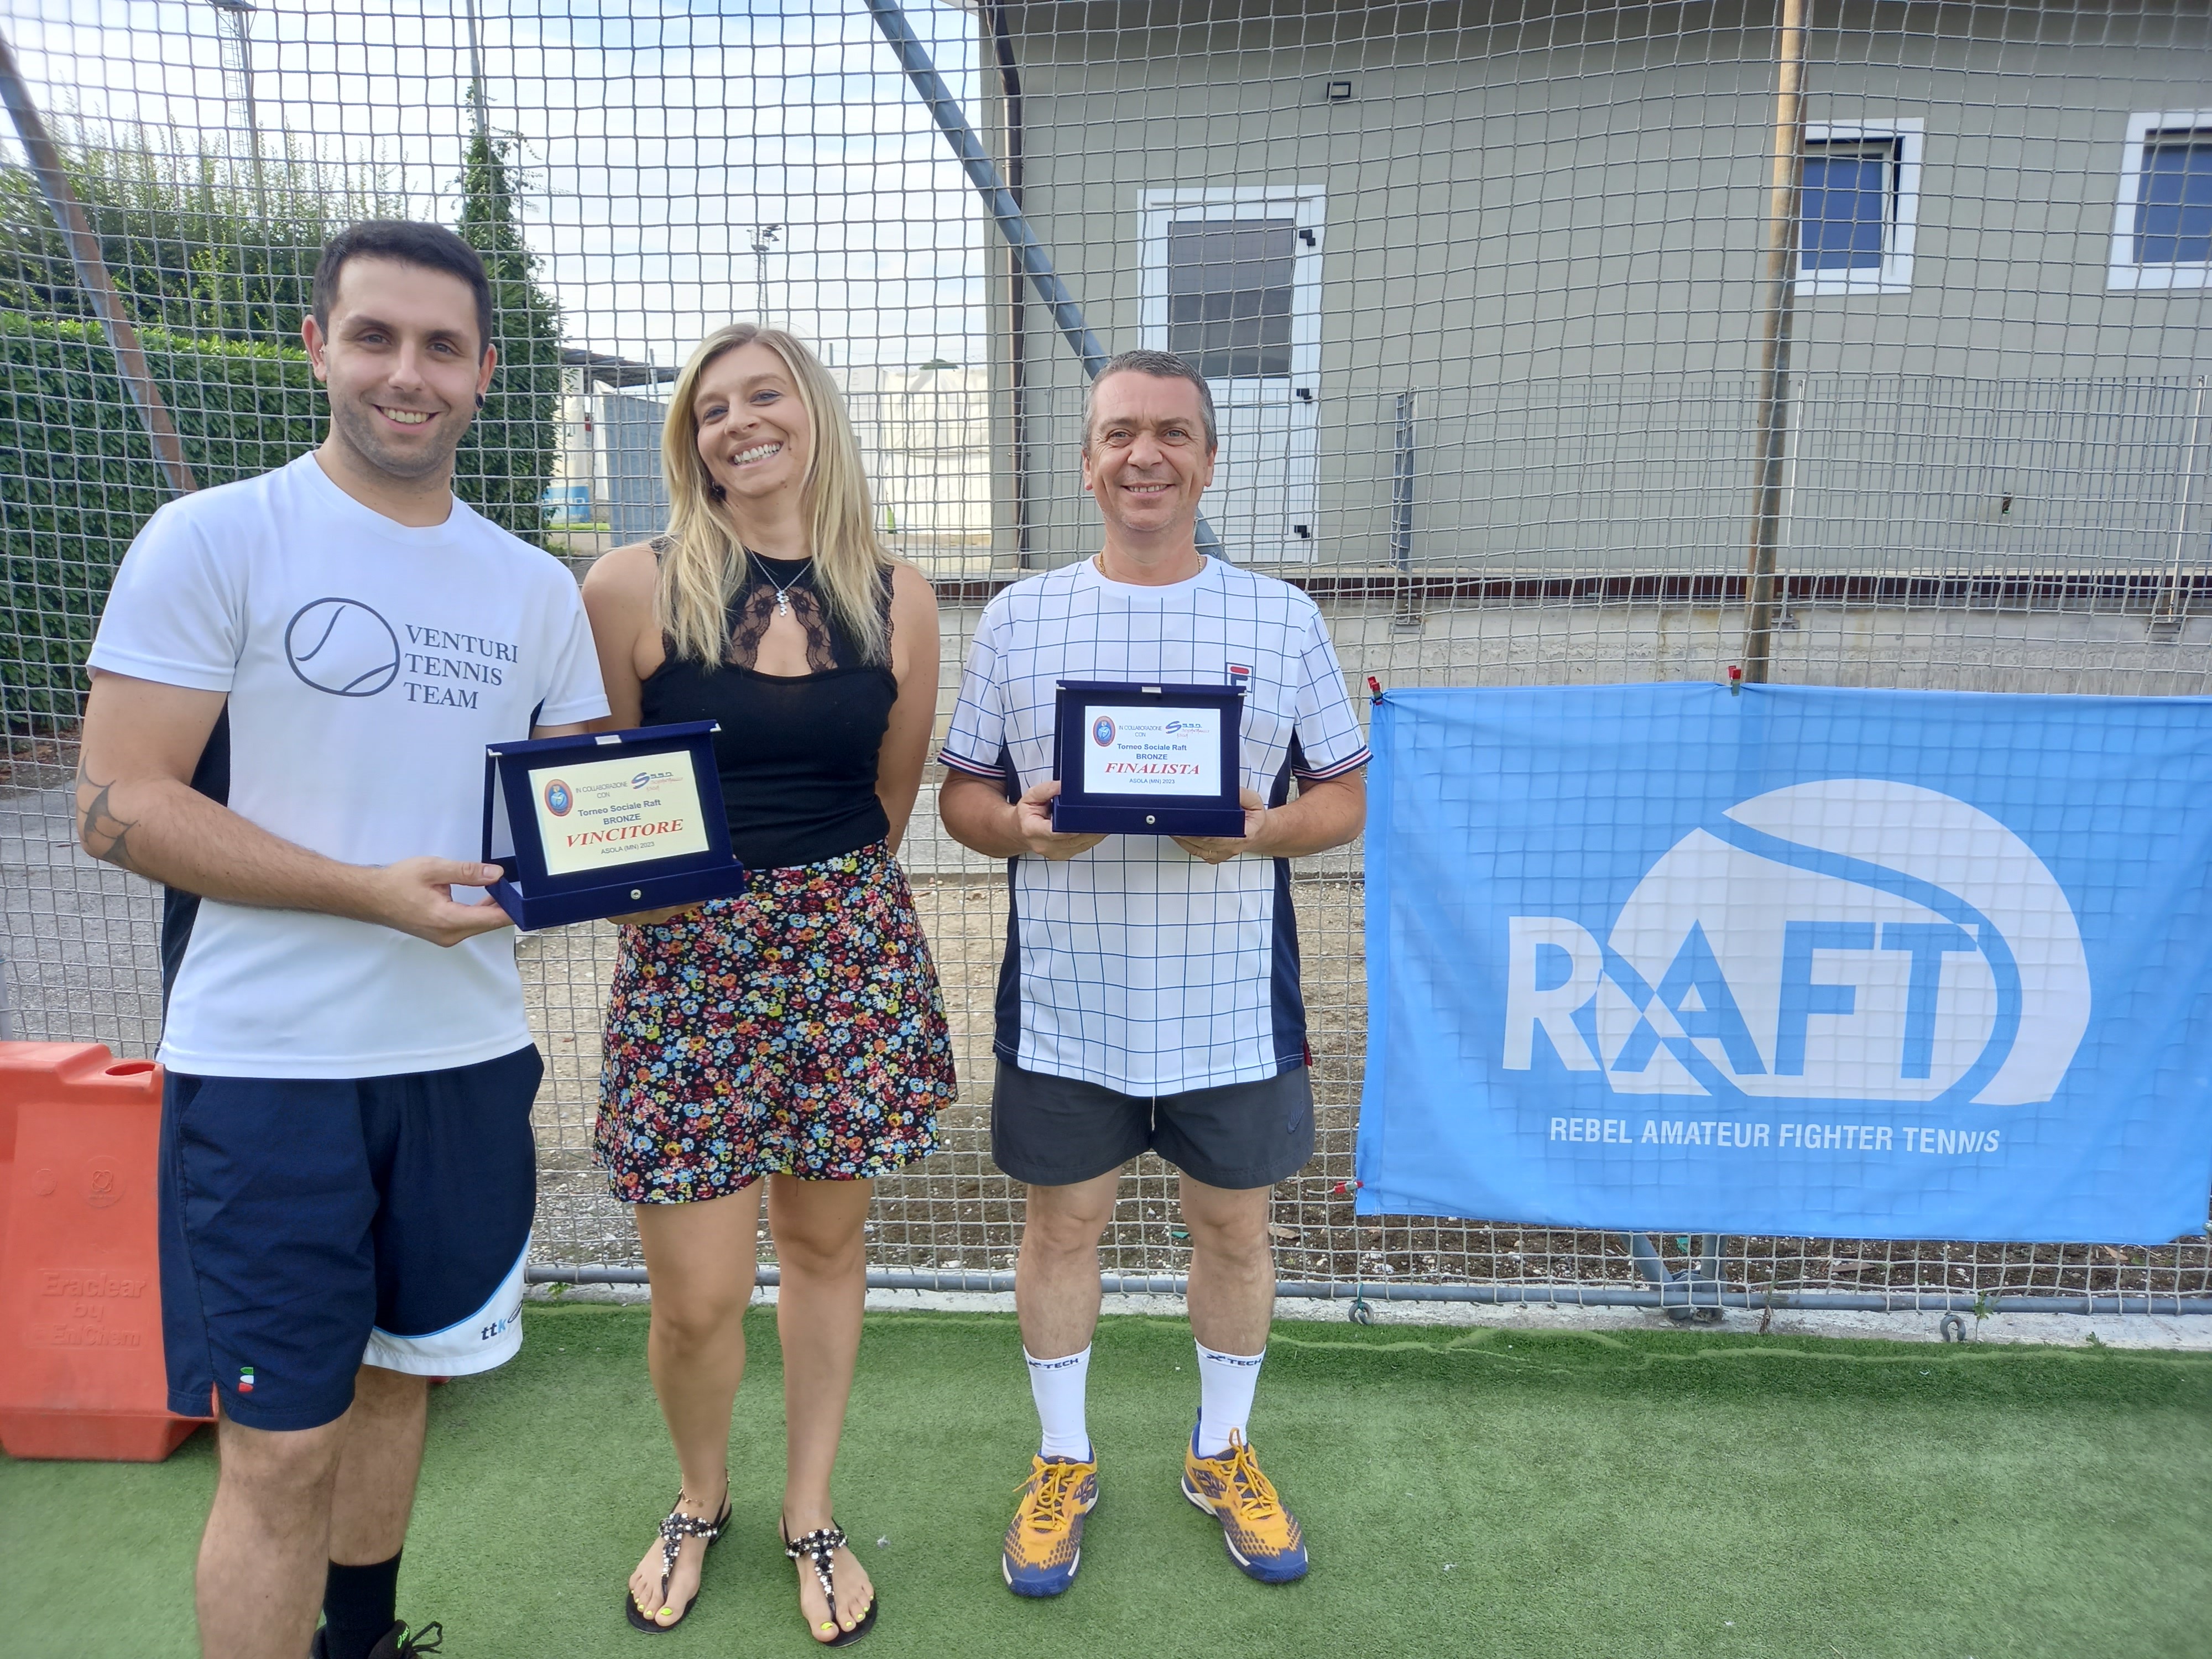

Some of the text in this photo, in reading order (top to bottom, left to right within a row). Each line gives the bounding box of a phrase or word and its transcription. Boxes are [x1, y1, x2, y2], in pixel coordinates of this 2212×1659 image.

[405, 624, 518, 664] VENTURI
[405, 653, 503, 686] TENNIS
[403, 681, 479, 709] TEAM
[1105, 763, 1199, 775] FINALISTA
[582, 781, 628, 792] COLLABORAZIONE
[578, 800, 661, 816] Torneo Sociale Raft
[603, 813, 641, 825] BRONZE
[566, 819, 684, 847] VINCITORE
[601, 846, 623, 854] ASOLA
[624, 844, 639, 853] (MN)
[1502, 916, 1979, 1079] RAFT
[1550, 1117, 2000, 1155] REBEL AMATEUR FIGHTER TENNIS
[42, 1272, 147, 1298] Eraclear
[72, 1301, 104, 1322] by
